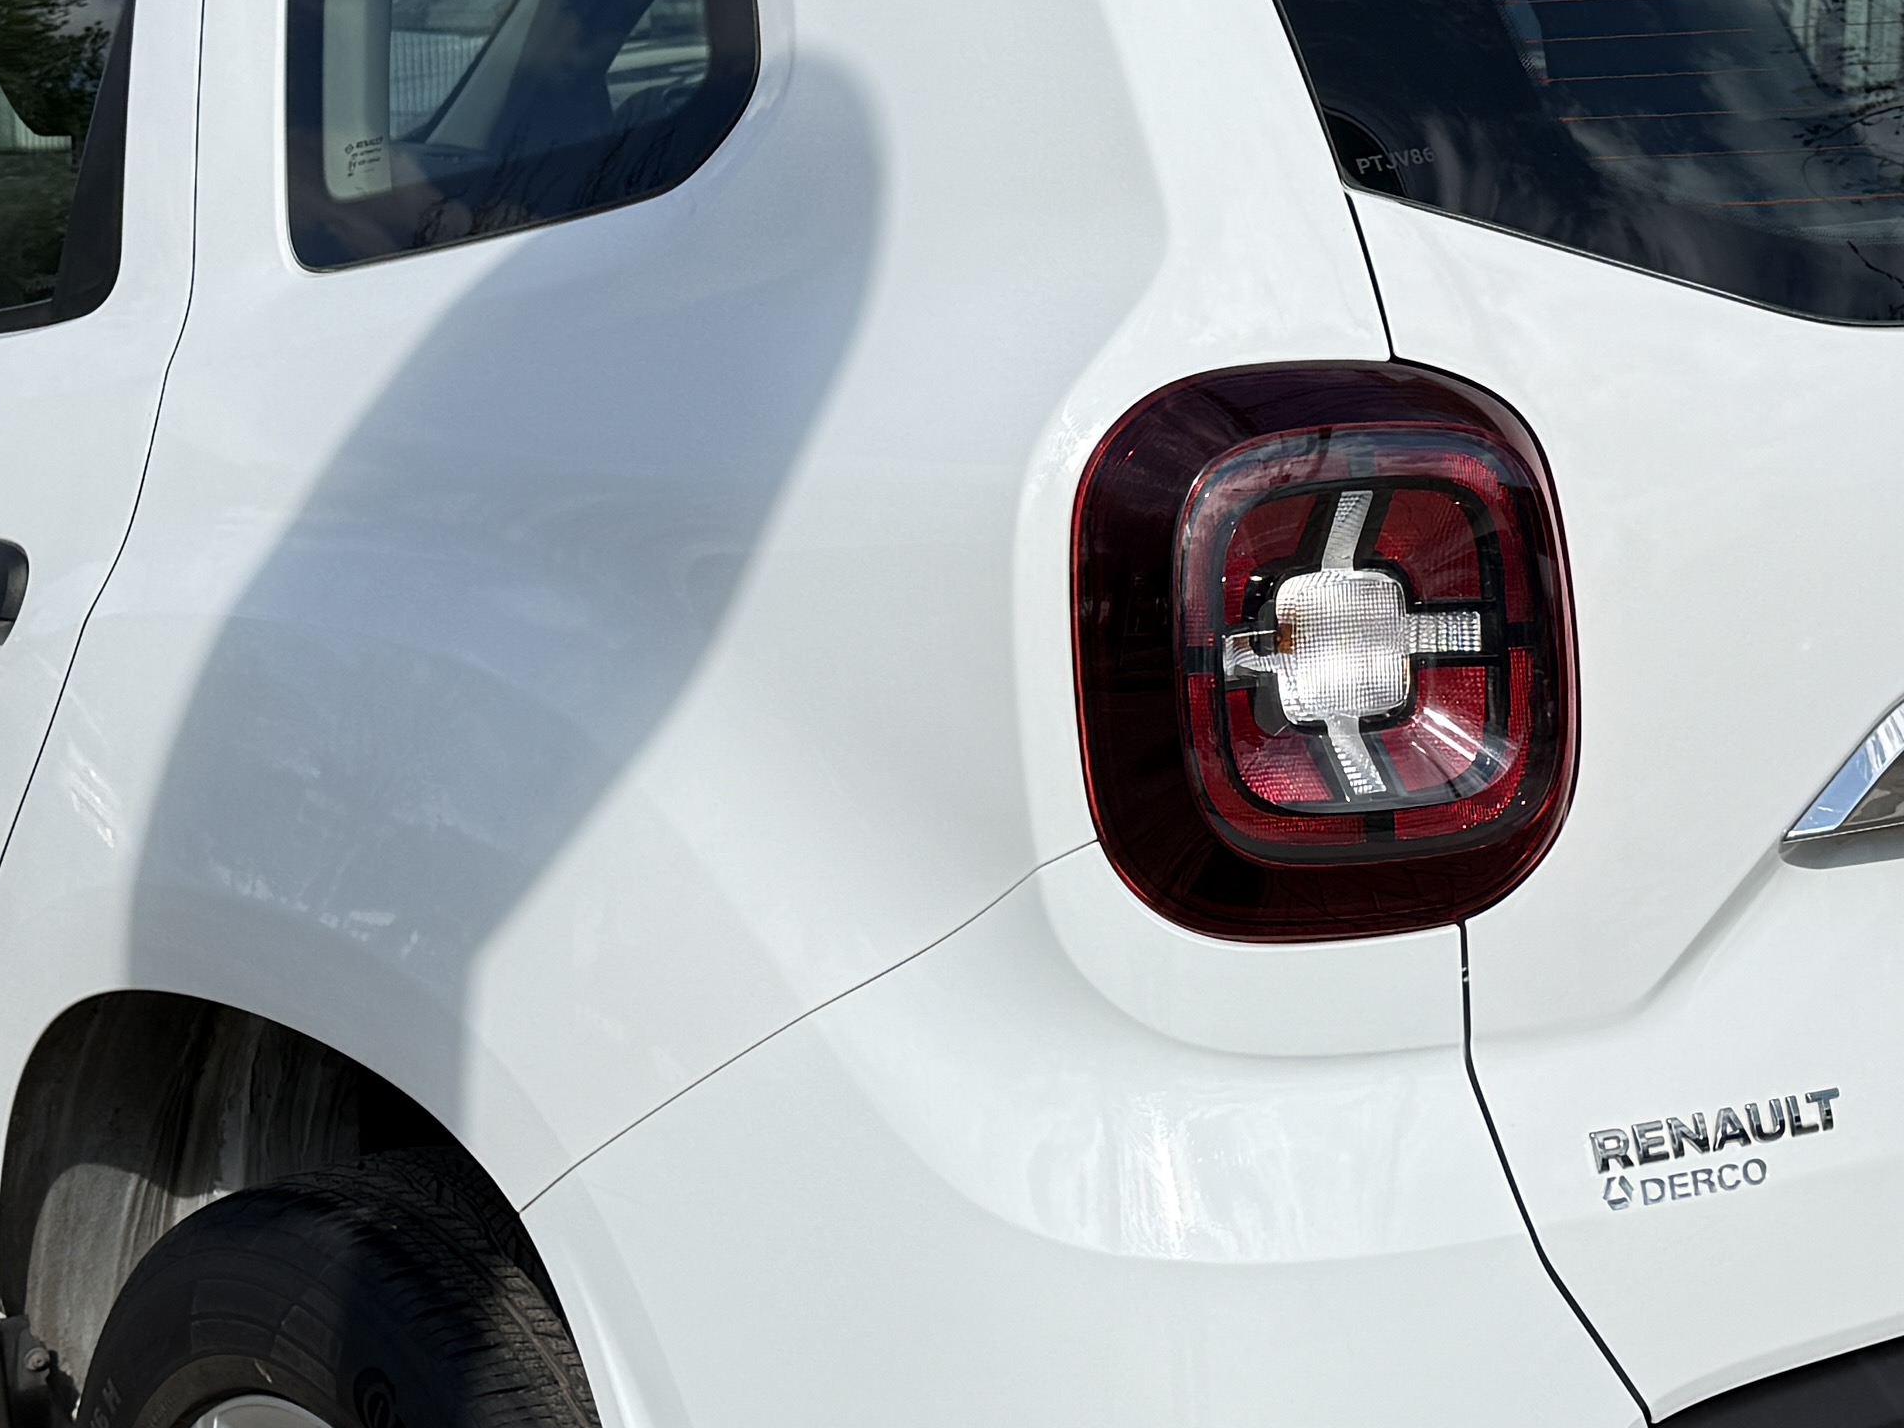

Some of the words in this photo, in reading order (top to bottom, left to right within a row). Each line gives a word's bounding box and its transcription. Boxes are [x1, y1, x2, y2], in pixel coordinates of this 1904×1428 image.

[1355, 147, 1435, 175] PTJV86
[1589, 1087, 1840, 1173] RENAULT
[1640, 1158, 1767, 1206] DERCO
